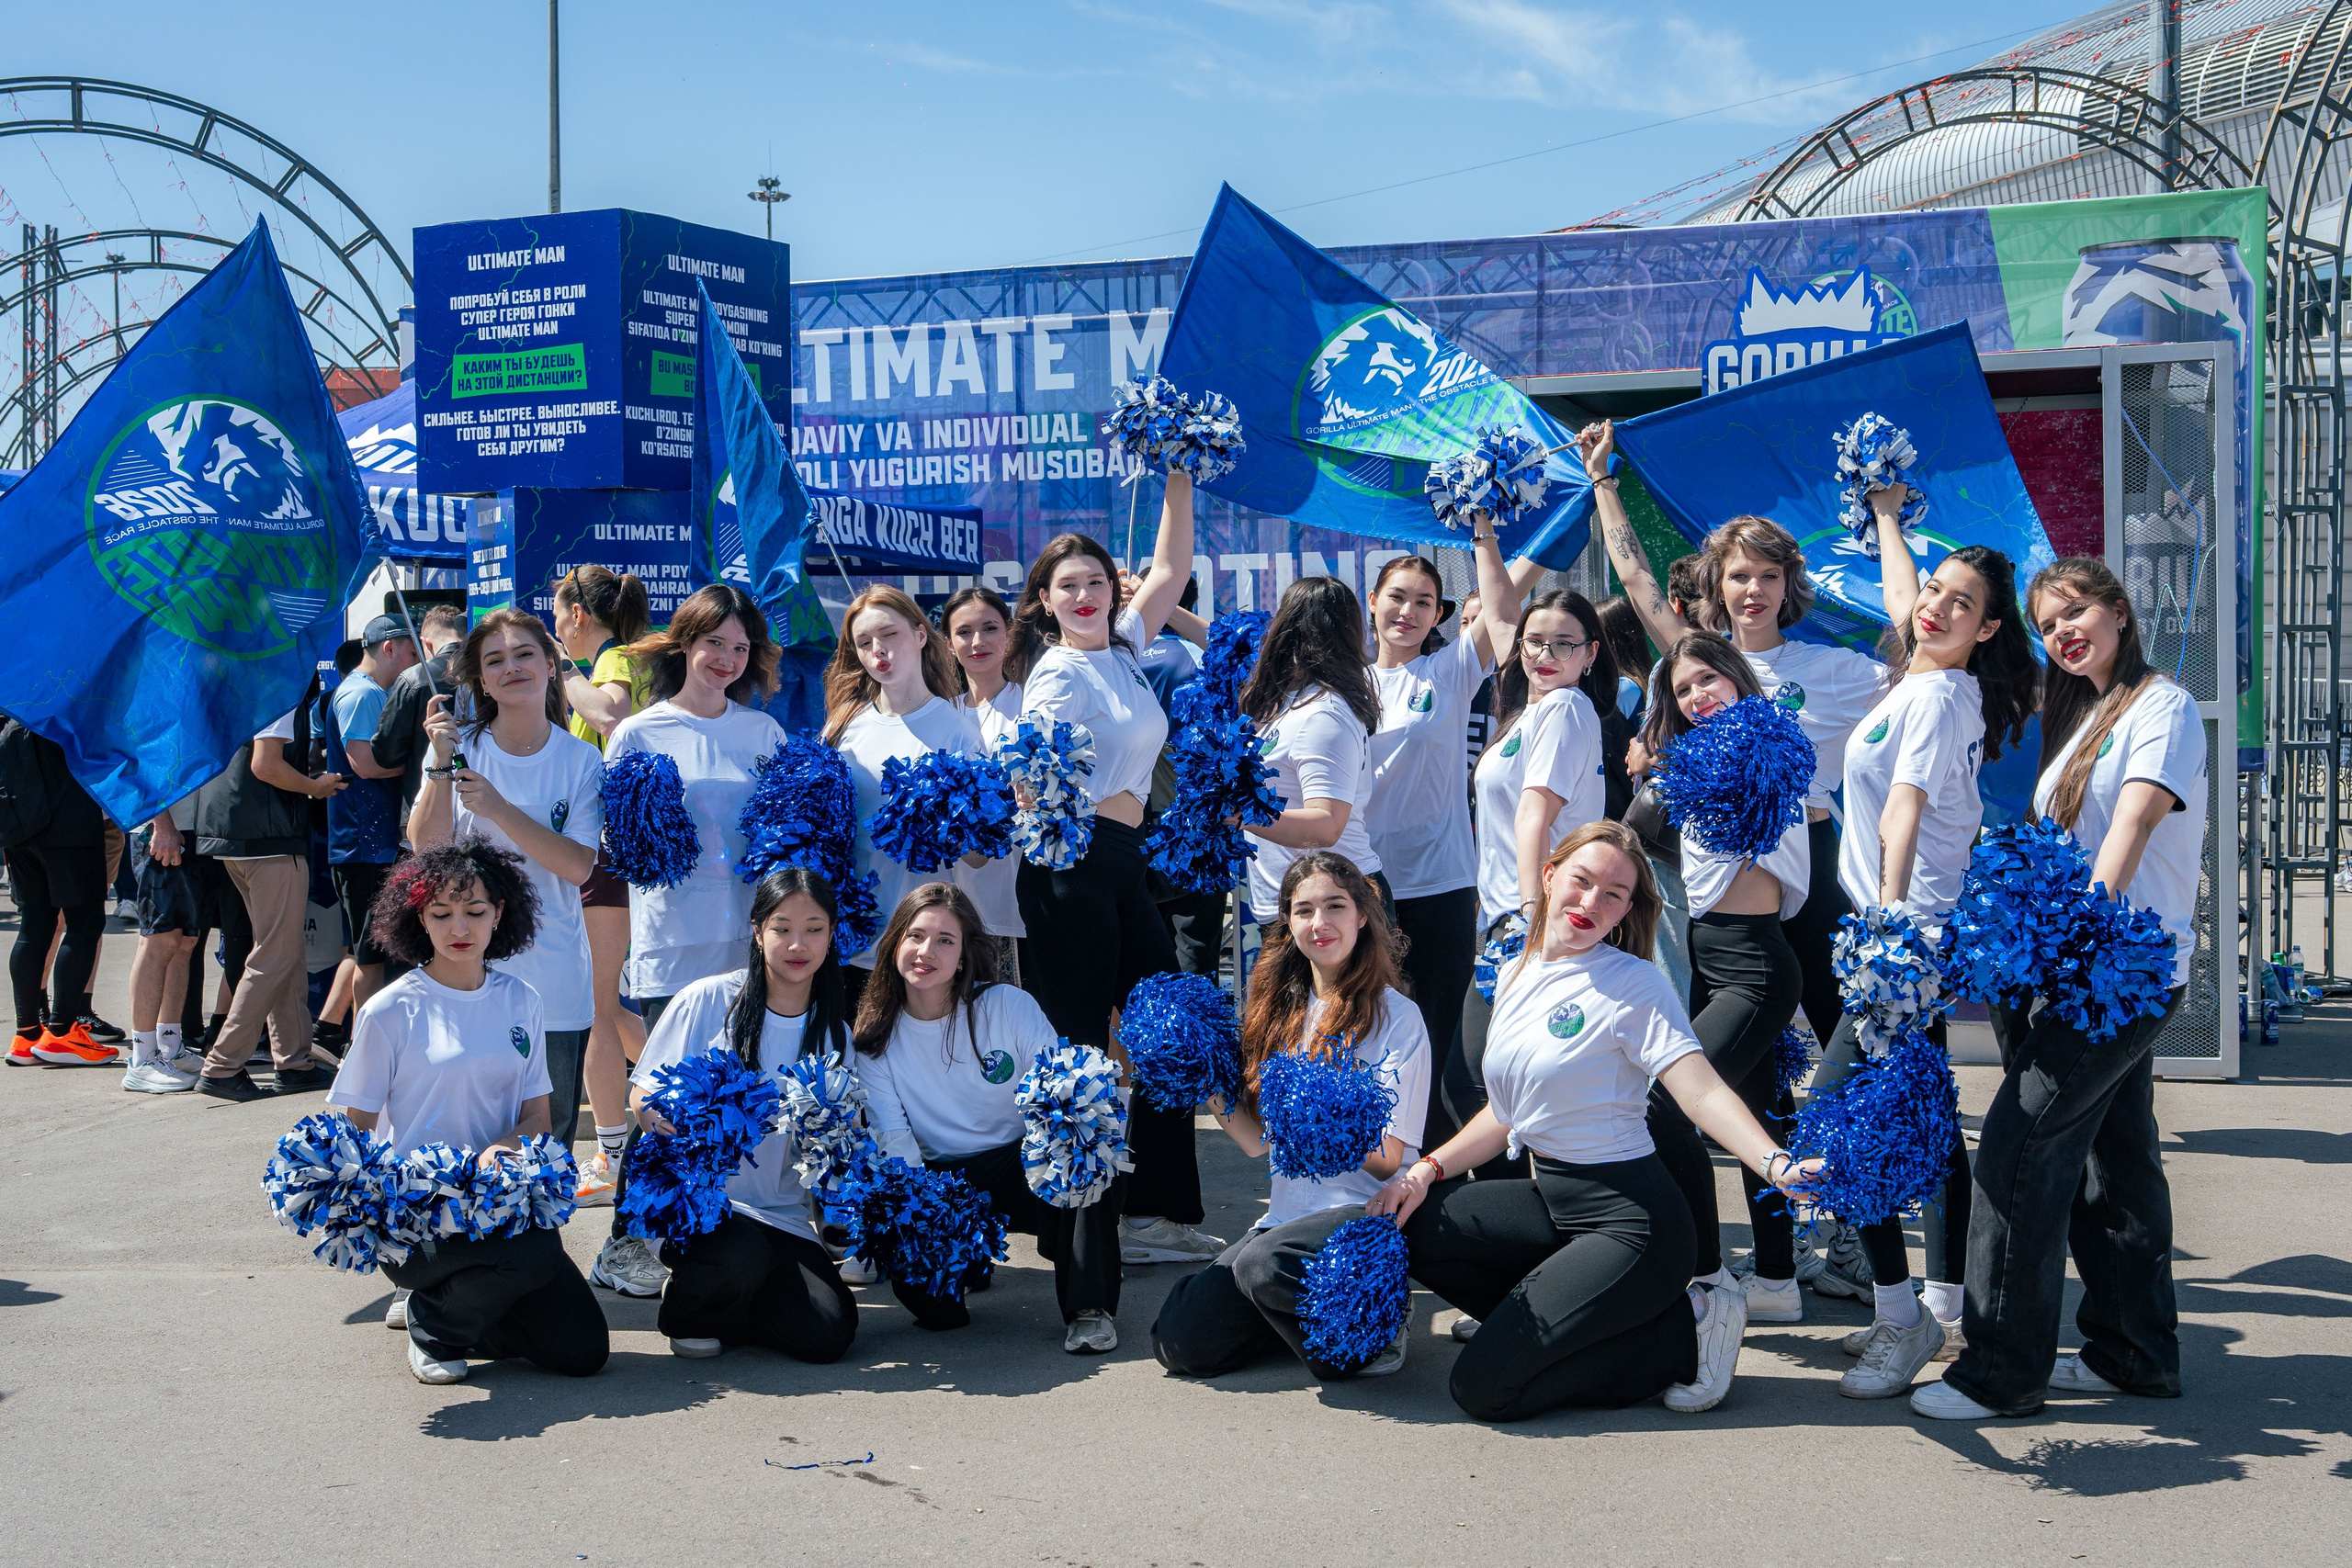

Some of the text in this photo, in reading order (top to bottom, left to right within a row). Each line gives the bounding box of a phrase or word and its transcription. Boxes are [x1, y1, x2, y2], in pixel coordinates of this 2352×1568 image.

[468, 245, 565, 271] ULTIMATE MAN
[668, 254, 745, 284] ULTIMATE MAN
[449, 284, 586, 310] ПОПРОБУЙ СЕБЯ В РОЛИ
[643, 289, 687, 310] ULTIMATE
[460, 301, 575, 326] СУПЕР ГЕРОЯ ГОНКИ
[665, 310, 695, 328] SUPER
[478, 321, 559, 341] ULTIMATE MAN
[628, 321, 670, 341] SIFATIDA
[748, 338, 782, 357] KO'RING
[463, 353, 575, 375] КАКИМ ТЫ БУДЕШЬ
[658, 359, 671, 373] BU
[673, 361, 695, 376] MAS
[1419, 352, 1491, 398] 202
[458, 369, 582, 391] НА ЭТОЙ ДИСТАНЦИИ?
[424, 400, 621, 427] СИЛЬНЕЕ. БЫСТРЕЕ. ВЫНОСЛИВЕЕ.
[626, 405, 680, 425] KUCHLIROQ.
[1306, 425, 1345, 434] GORILLA
[1347, 412, 1389, 429] ULTIMATE
[1418, 393, 1437, 405] THE
[1439, 378, 1487, 399] OBSTACLE
[457, 420, 586, 442] ГОТОВ ЛИ ТЫ УВИДЕТЬ
[876, 421, 913, 451] VA
[924, 412, 1088, 448] INDIVIDUAL
[478, 437, 565, 457] СЕБЯ ДРУГИМ?
[848, 453, 990, 488] YUGURISH
[594, 524, 674, 541] ULTIMATE
[874, 503, 937, 558] KUCH
[940, 516, 980, 565] BER
[627, 564, 659, 578] MAN
